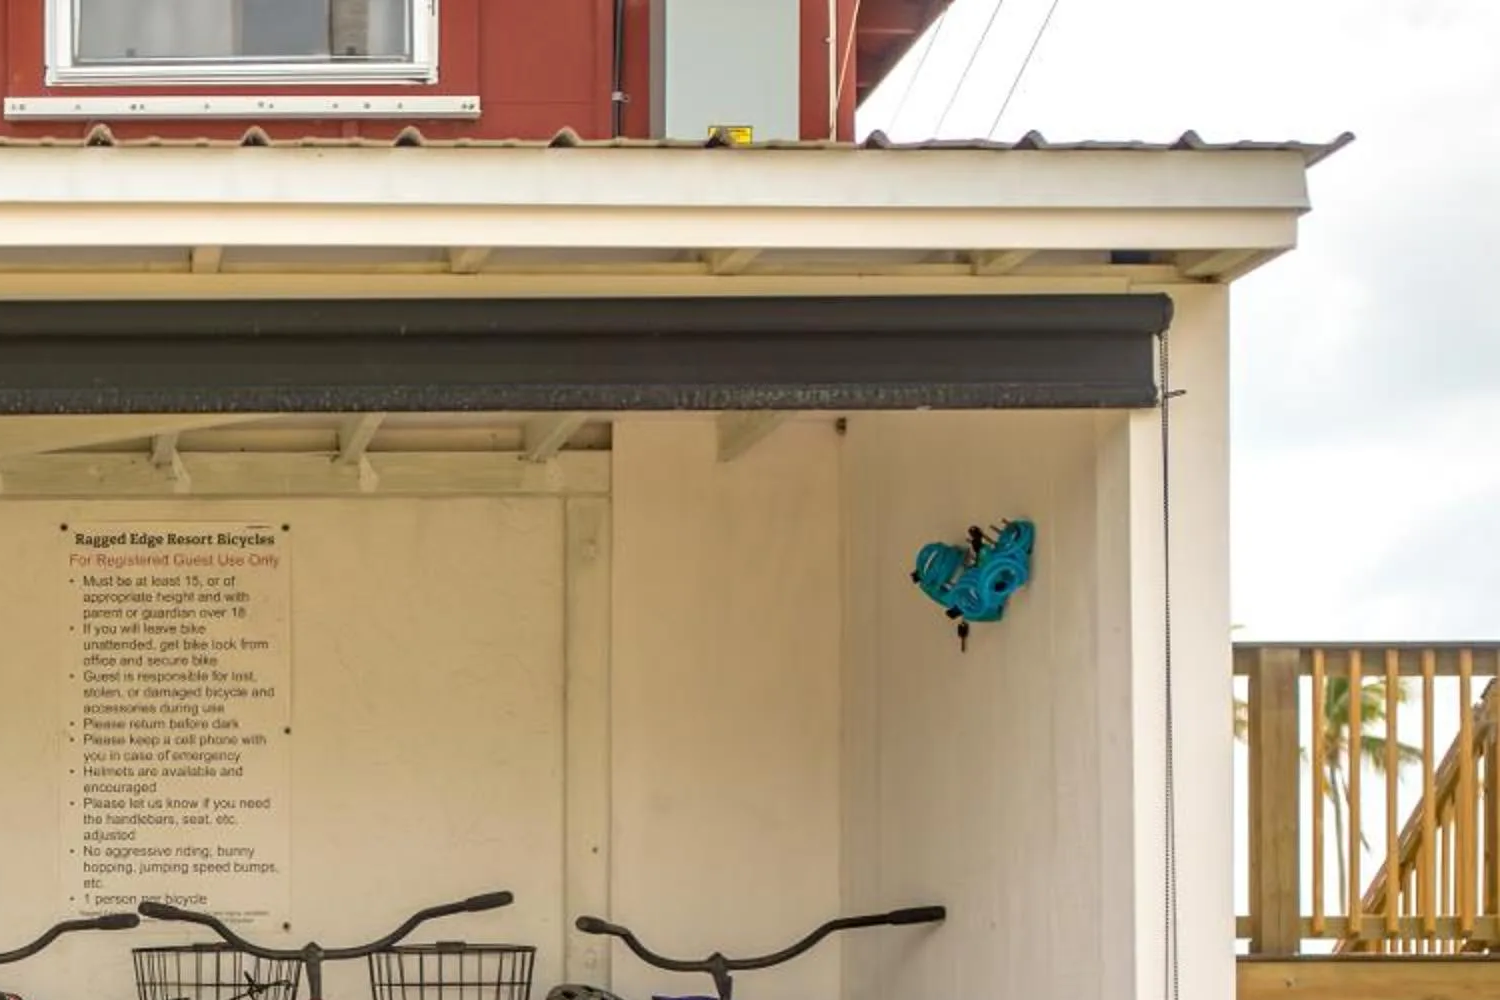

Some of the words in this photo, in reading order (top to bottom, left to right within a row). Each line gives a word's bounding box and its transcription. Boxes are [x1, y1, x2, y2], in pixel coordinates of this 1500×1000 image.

[75, 533, 126, 548] Ragged
[130, 533, 164, 548] Edge
[167, 533, 213, 545] Resort
[217, 533, 275, 548] Bicycles
[69, 554, 92, 566] For
[96, 553, 169, 569] Registered
[173, 553, 214, 567] Guest
[218, 554, 244, 567] Use
[250, 553, 279, 569] Only
[83, 576, 114, 587] Must
[117, 576, 133, 587] be
[135, 576, 147, 587] at
[151, 576, 181, 587] least
[207, 578, 220, 587] or
[223, 576, 236, 587] of
[83, 593, 153, 603] appropriate
[156, 592, 195, 603] height
[198, 592, 221, 603] and
[224, 592, 250, 603] with
[83, 608, 122, 620] parent
[125, 609, 138, 619] or
[142, 608, 196, 620] guardian
[199, 609, 227, 619] over
[231, 607, 246, 618] 18
[94, 626, 117, 636] you
[119, 623, 140, 634] will
[143, 623, 177, 634] leave
[180, 623, 206, 634] bike
[160, 640, 179, 652] get
[183, 639, 209, 651] bike
[212, 639, 237, 651] lock
[241, 639, 269, 651] from
[83, 655, 117, 666] office
[119, 655, 143, 666] and
[147, 656, 189, 666] secure
[192, 655, 218, 666] bike
[83, 671, 121, 682] Guest
[124, 671, 134, 682] is
[137, 671, 209, 684] responsible
[211, 671, 228, 682] for
[127, 688, 140, 698] or
[143, 687, 201, 700] damaged
[205, 687, 248, 700] bicycle
[251, 687, 275, 698] and
[160, 703, 199, 716] during
[202, 704, 225, 714] use
[83, 719, 126, 730] Please
[129, 719, 165, 730] return
[169, 718, 209, 730] before
[212, 718, 239, 729] dark
[83, 734, 126, 745] Please
[129, 734, 161, 748] keep
[174, 734, 196, 745] cell
[199, 734, 238, 748] phone
[241, 734, 267, 745] with
[83, 752, 106, 763] you
[109, 750, 121, 761] in
[124, 751, 154, 761] case
[157, 750, 170, 761] of
[171, 751, 241, 763] emergency
[83, 766, 135, 777] Helmets
[137, 767, 158, 777] are
[161, 766, 217, 777] available
[220, 766, 243, 777] and
[83, 782, 157, 796] encouraged
[83, 798, 126, 809] Please
[129, 798, 145, 809] let
[148, 799, 163, 809] us
[166, 798, 199, 809] know
[213, 800, 236, 811] you
[239, 798, 271, 809] need
[83, 814, 103, 825] the
[83, 830, 136, 843] adjusted
[83, 846, 101, 857] No
[105, 846, 173, 859] aggressive
[217, 845, 255, 859] bunny
[139, 862, 189, 875] jumping
[192, 862, 231, 875] speed
[95, 894, 137, 906] person
[165, 894, 208, 906] bicycle
